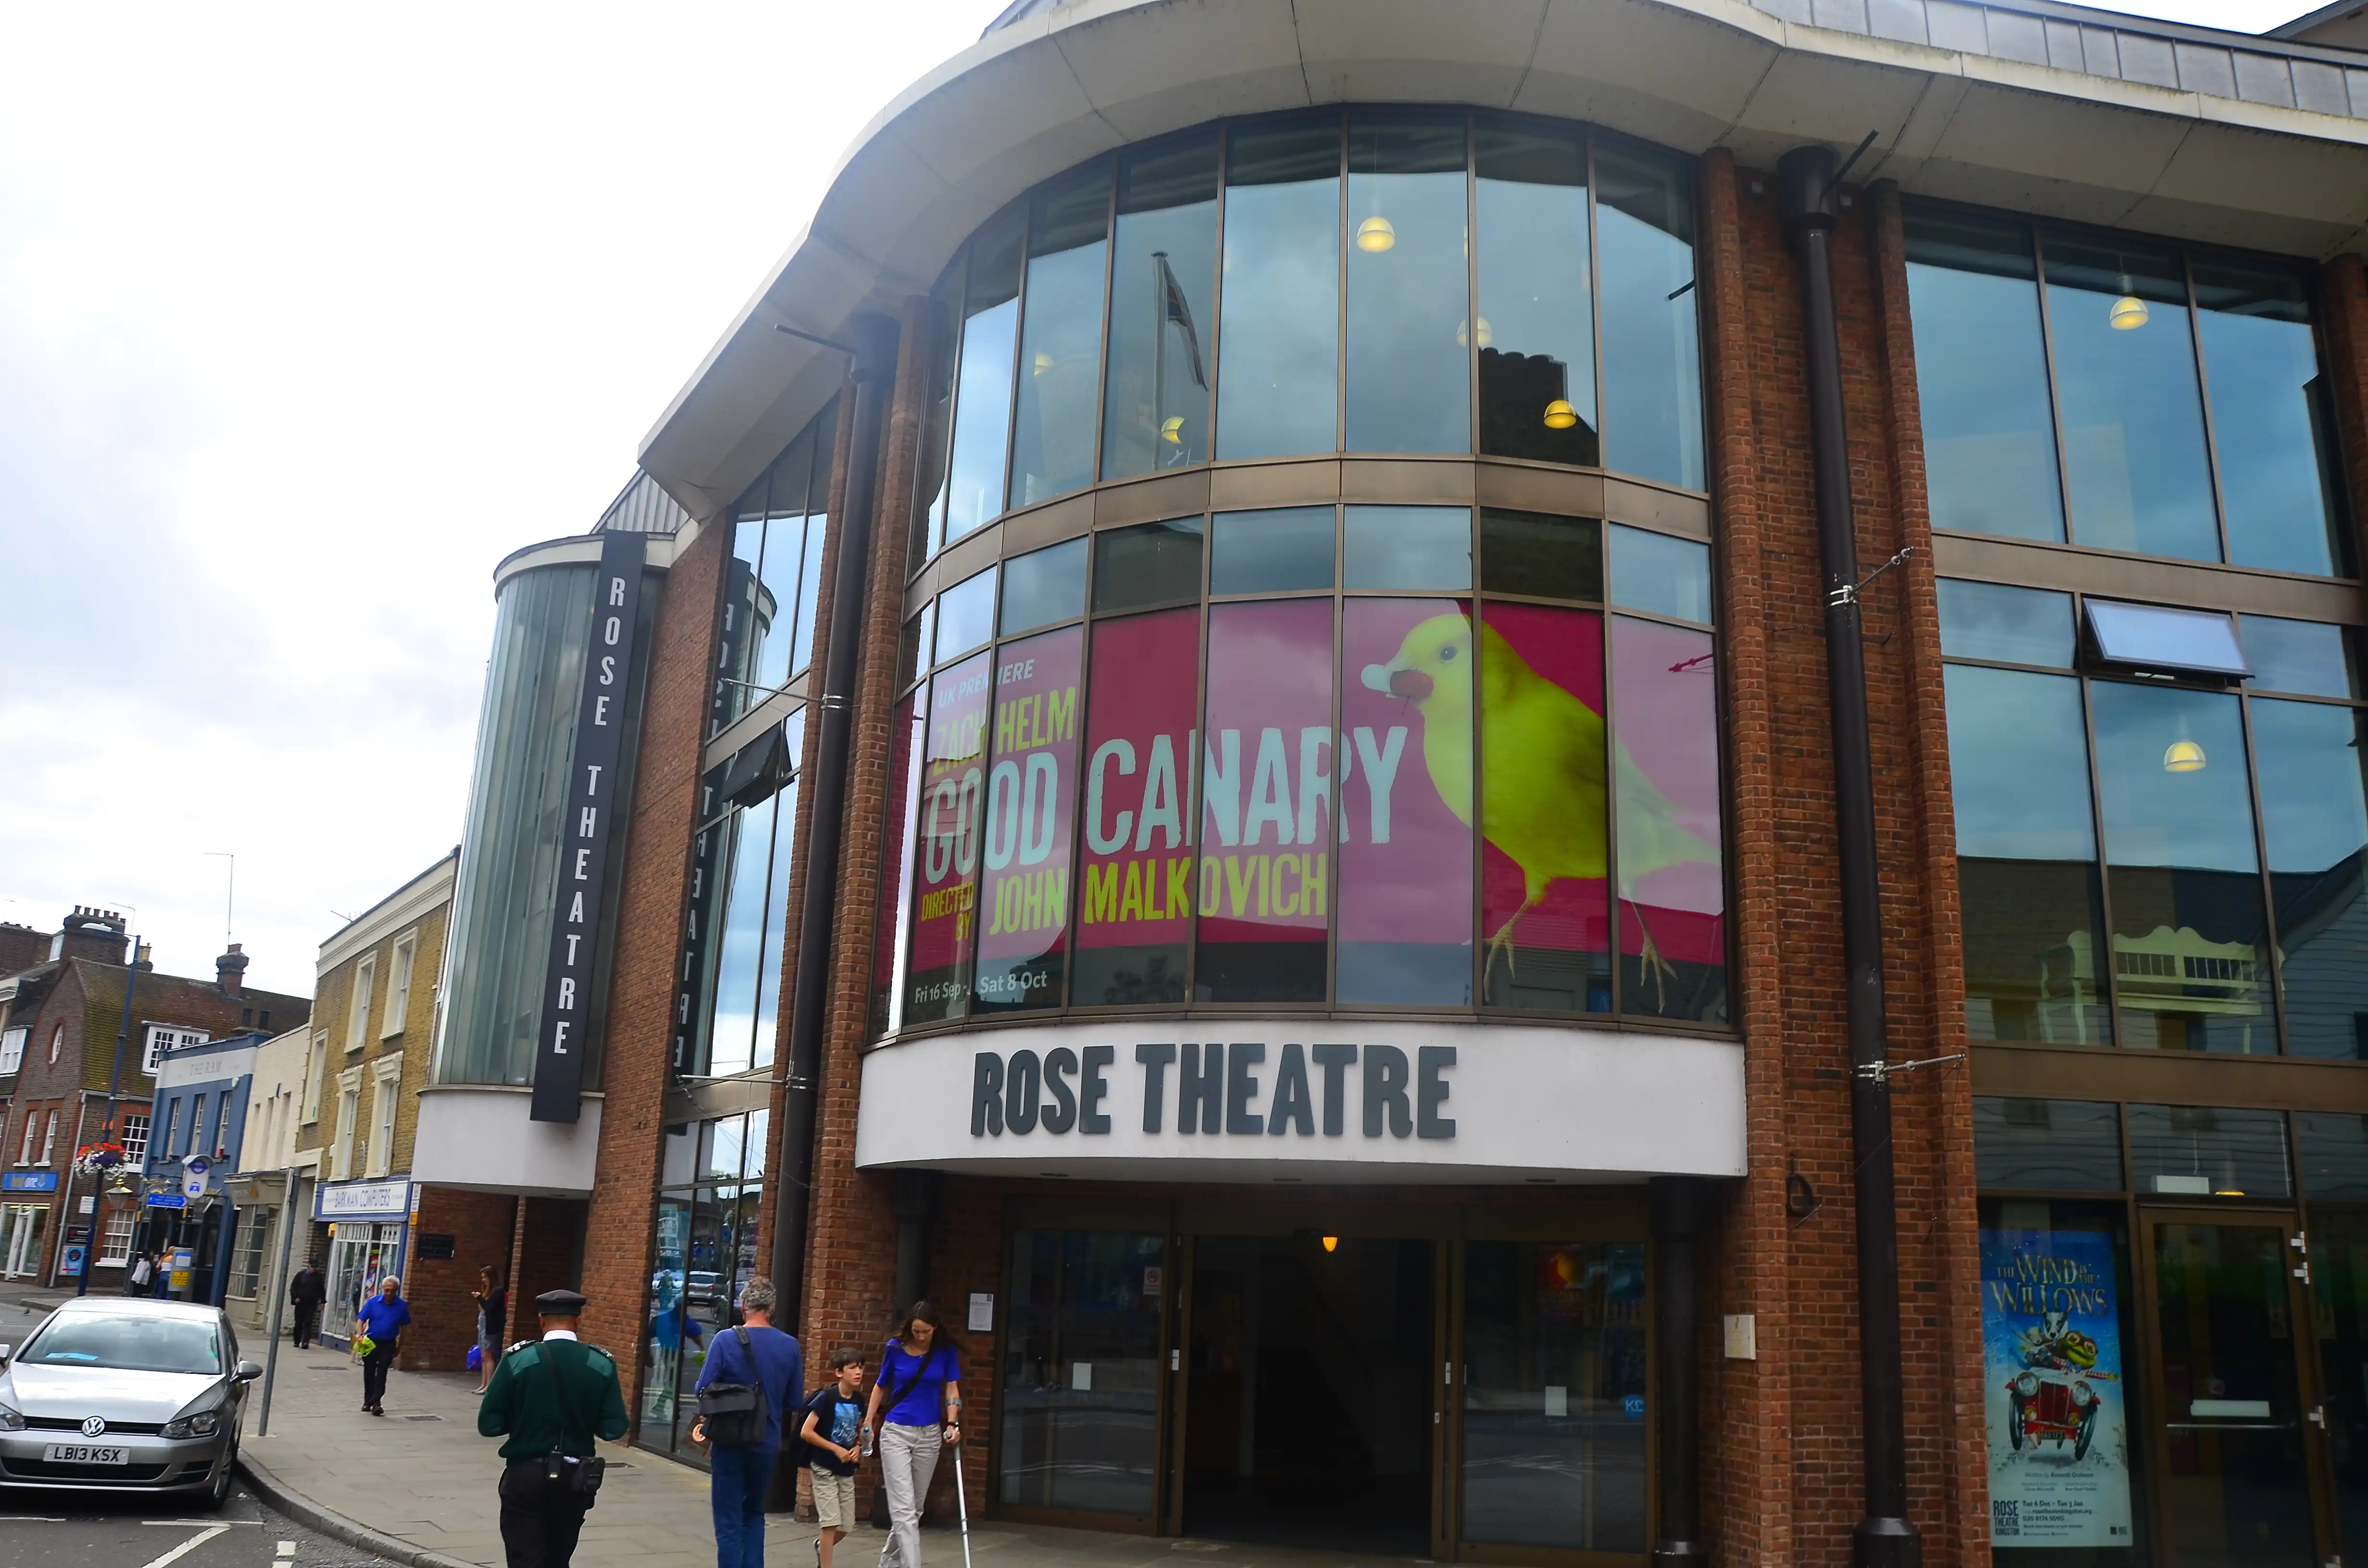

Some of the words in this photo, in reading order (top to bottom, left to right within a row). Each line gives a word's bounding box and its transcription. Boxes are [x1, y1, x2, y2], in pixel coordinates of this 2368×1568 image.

[594, 577, 625, 726] ROSE
[939, 685, 956, 708] UK
[997, 687, 1075, 755] HELM
[925, 752, 1058, 883] GOOD
[1087, 726, 1408, 855] CANARY
[554, 765, 602, 1054] THEATRE
[921, 882, 974, 921] DIRECTED
[989, 868, 1066, 935] JOHN
[1084, 853, 1326, 924] MALKOVICH
[956, 912, 972, 942] BY
[915, 987, 928, 1003] Fri
[930, 984, 940, 1000] 16
[943, 982, 961, 1000] Sep
[980, 975, 1003, 993] Sat
[1007, 974, 1016, 991] 8
[1021, 971, 1047, 989] Oct
[970, 1045, 1114, 1137] ROSE
[1135, 1043, 1457, 1139] THEATRE
[1998, 1267, 2014, 1277] THE
[2014, 1255, 2077, 1285] WIND
[1989, 1282, 2108, 1315] WILLOWS
[54, 1446, 87, 1460] LB13
[91, 1448, 121, 1461] KSX
[1993, 1500, 2018, 1516] ROSE
[1995, 1516, 2018, 1527] THEATRE
